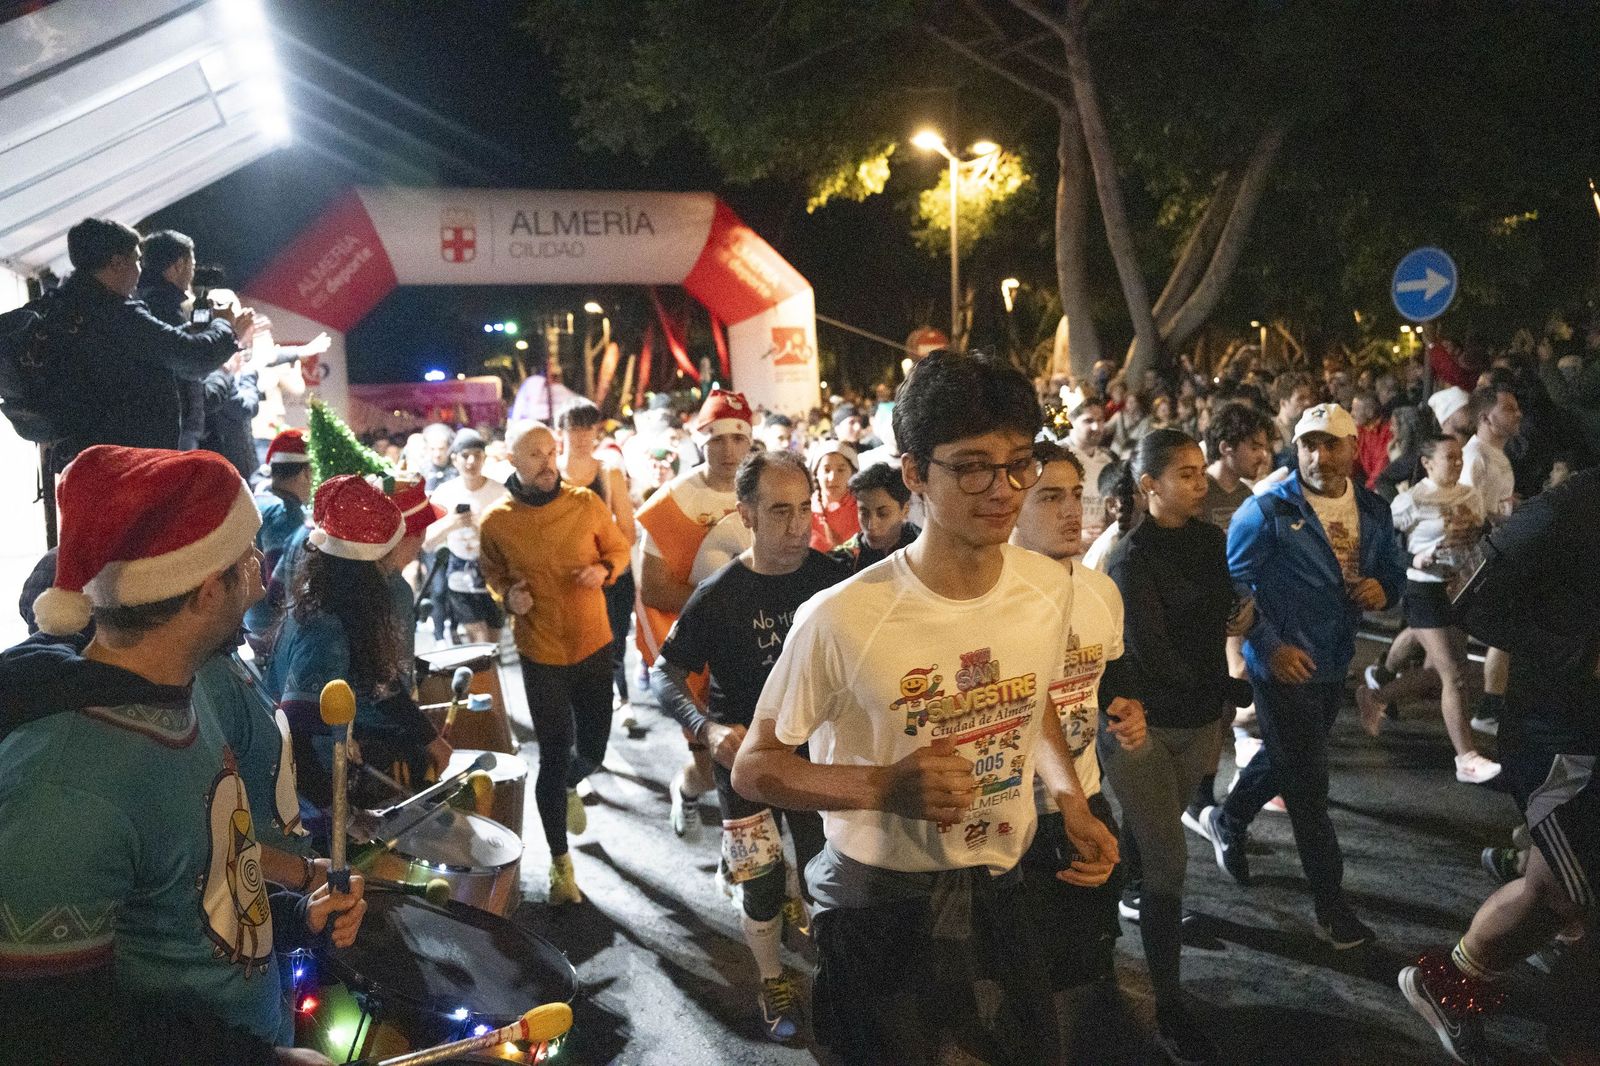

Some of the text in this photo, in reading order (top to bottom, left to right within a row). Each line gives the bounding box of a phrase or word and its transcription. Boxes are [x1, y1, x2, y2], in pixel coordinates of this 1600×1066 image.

[508, 204, 656, 236] ALMERÍA
[508, 241, 586, 259] CIUDAD
[752, 609, 774, 630] NO
[758, 630, 782, 650] LA
[1063, 643, 1103, 667] ESTRE
[955, 660, 1000, 692] SAN
[926, 672, 1037, 724] SILVESTRE
[931, 717, 976, 737] Ciudad
[978, 714, 991, 726] de
[975, 751, 1005, 777] 005
